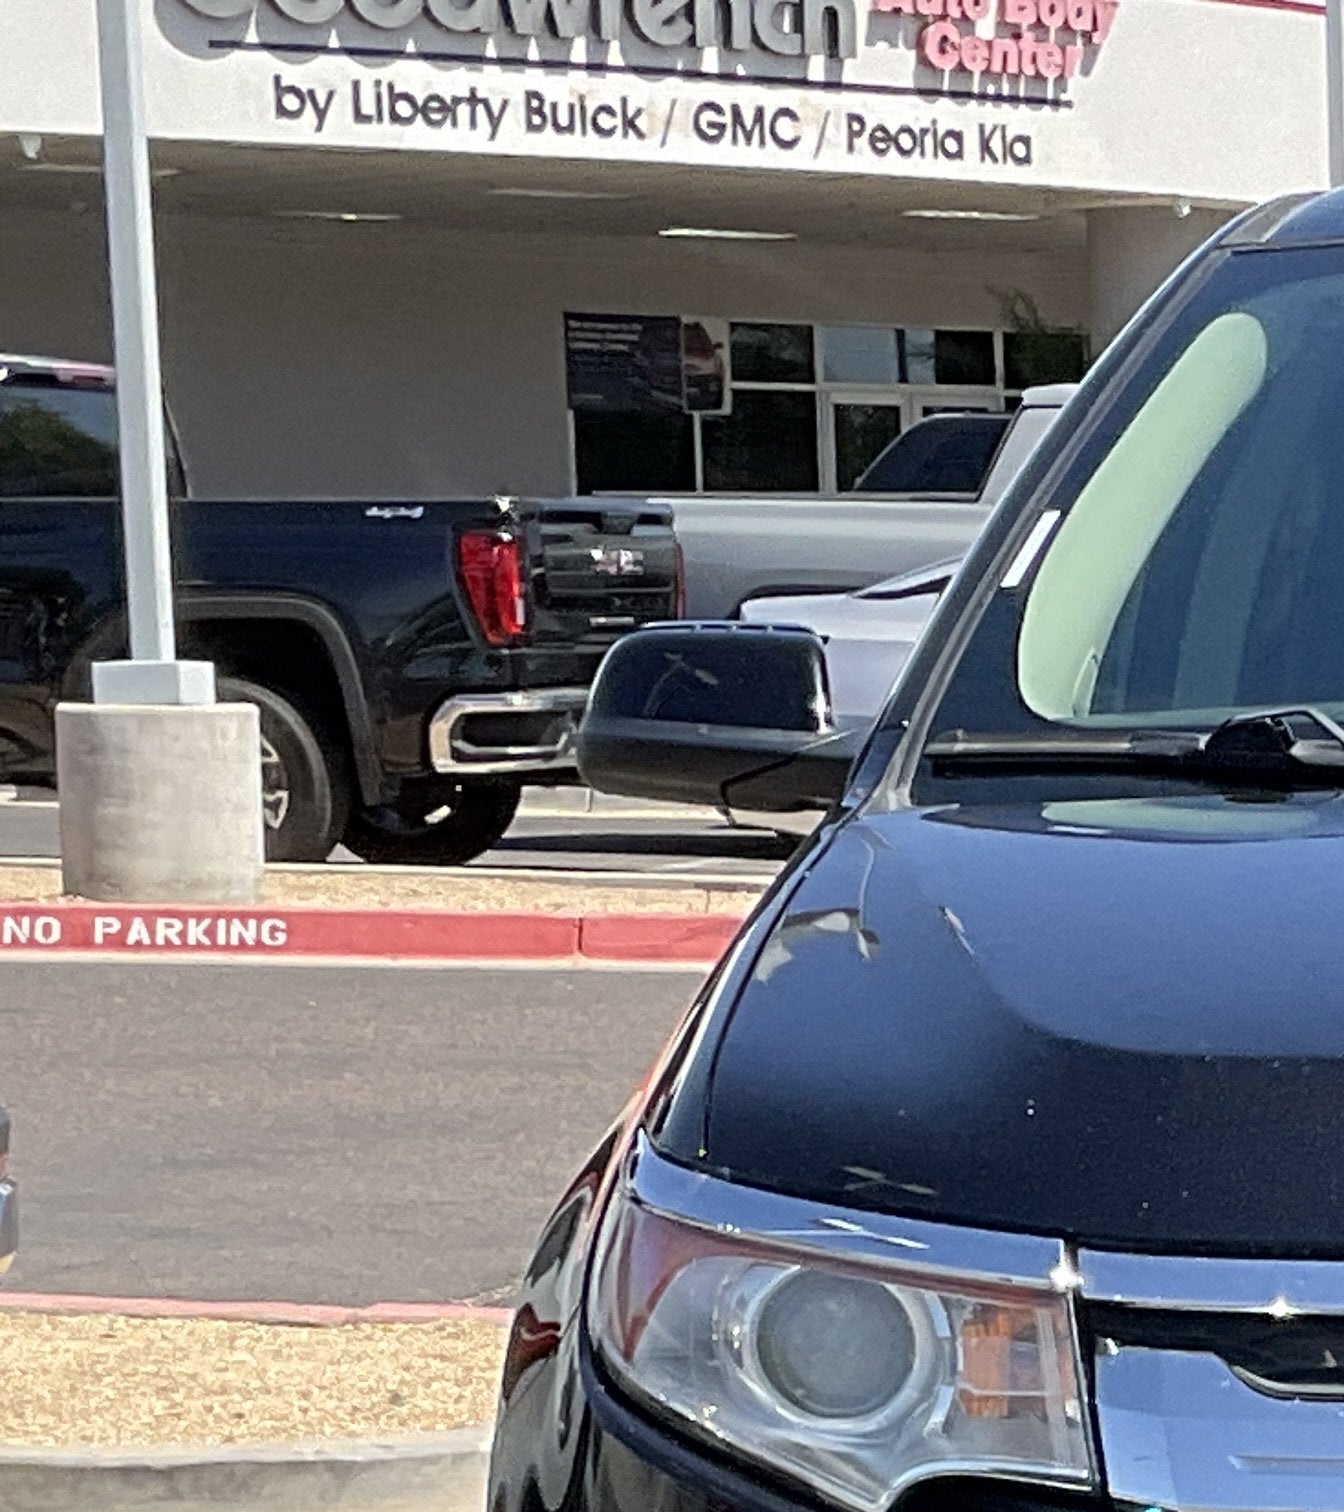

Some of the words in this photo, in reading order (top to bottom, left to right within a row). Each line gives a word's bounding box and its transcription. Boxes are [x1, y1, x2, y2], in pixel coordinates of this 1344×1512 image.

[170, 0, 858, 58] wrench
[920, 21, 1085, 79] Center
[273, 74, 337, 132] by
[352, 79, 509, 141] Liberty
[524, 89, 647, 141] Buick
[659, 98, 678, 149] /
[692, 101, 801, 150] GMC
[813, 110, 831, 160] /
[846, 112, 964, 161] Peoria
[978, 123, 1033, 167] Kia
[2, 915, 61, 944] NO
[94, 916, 288, 946] PARKING
